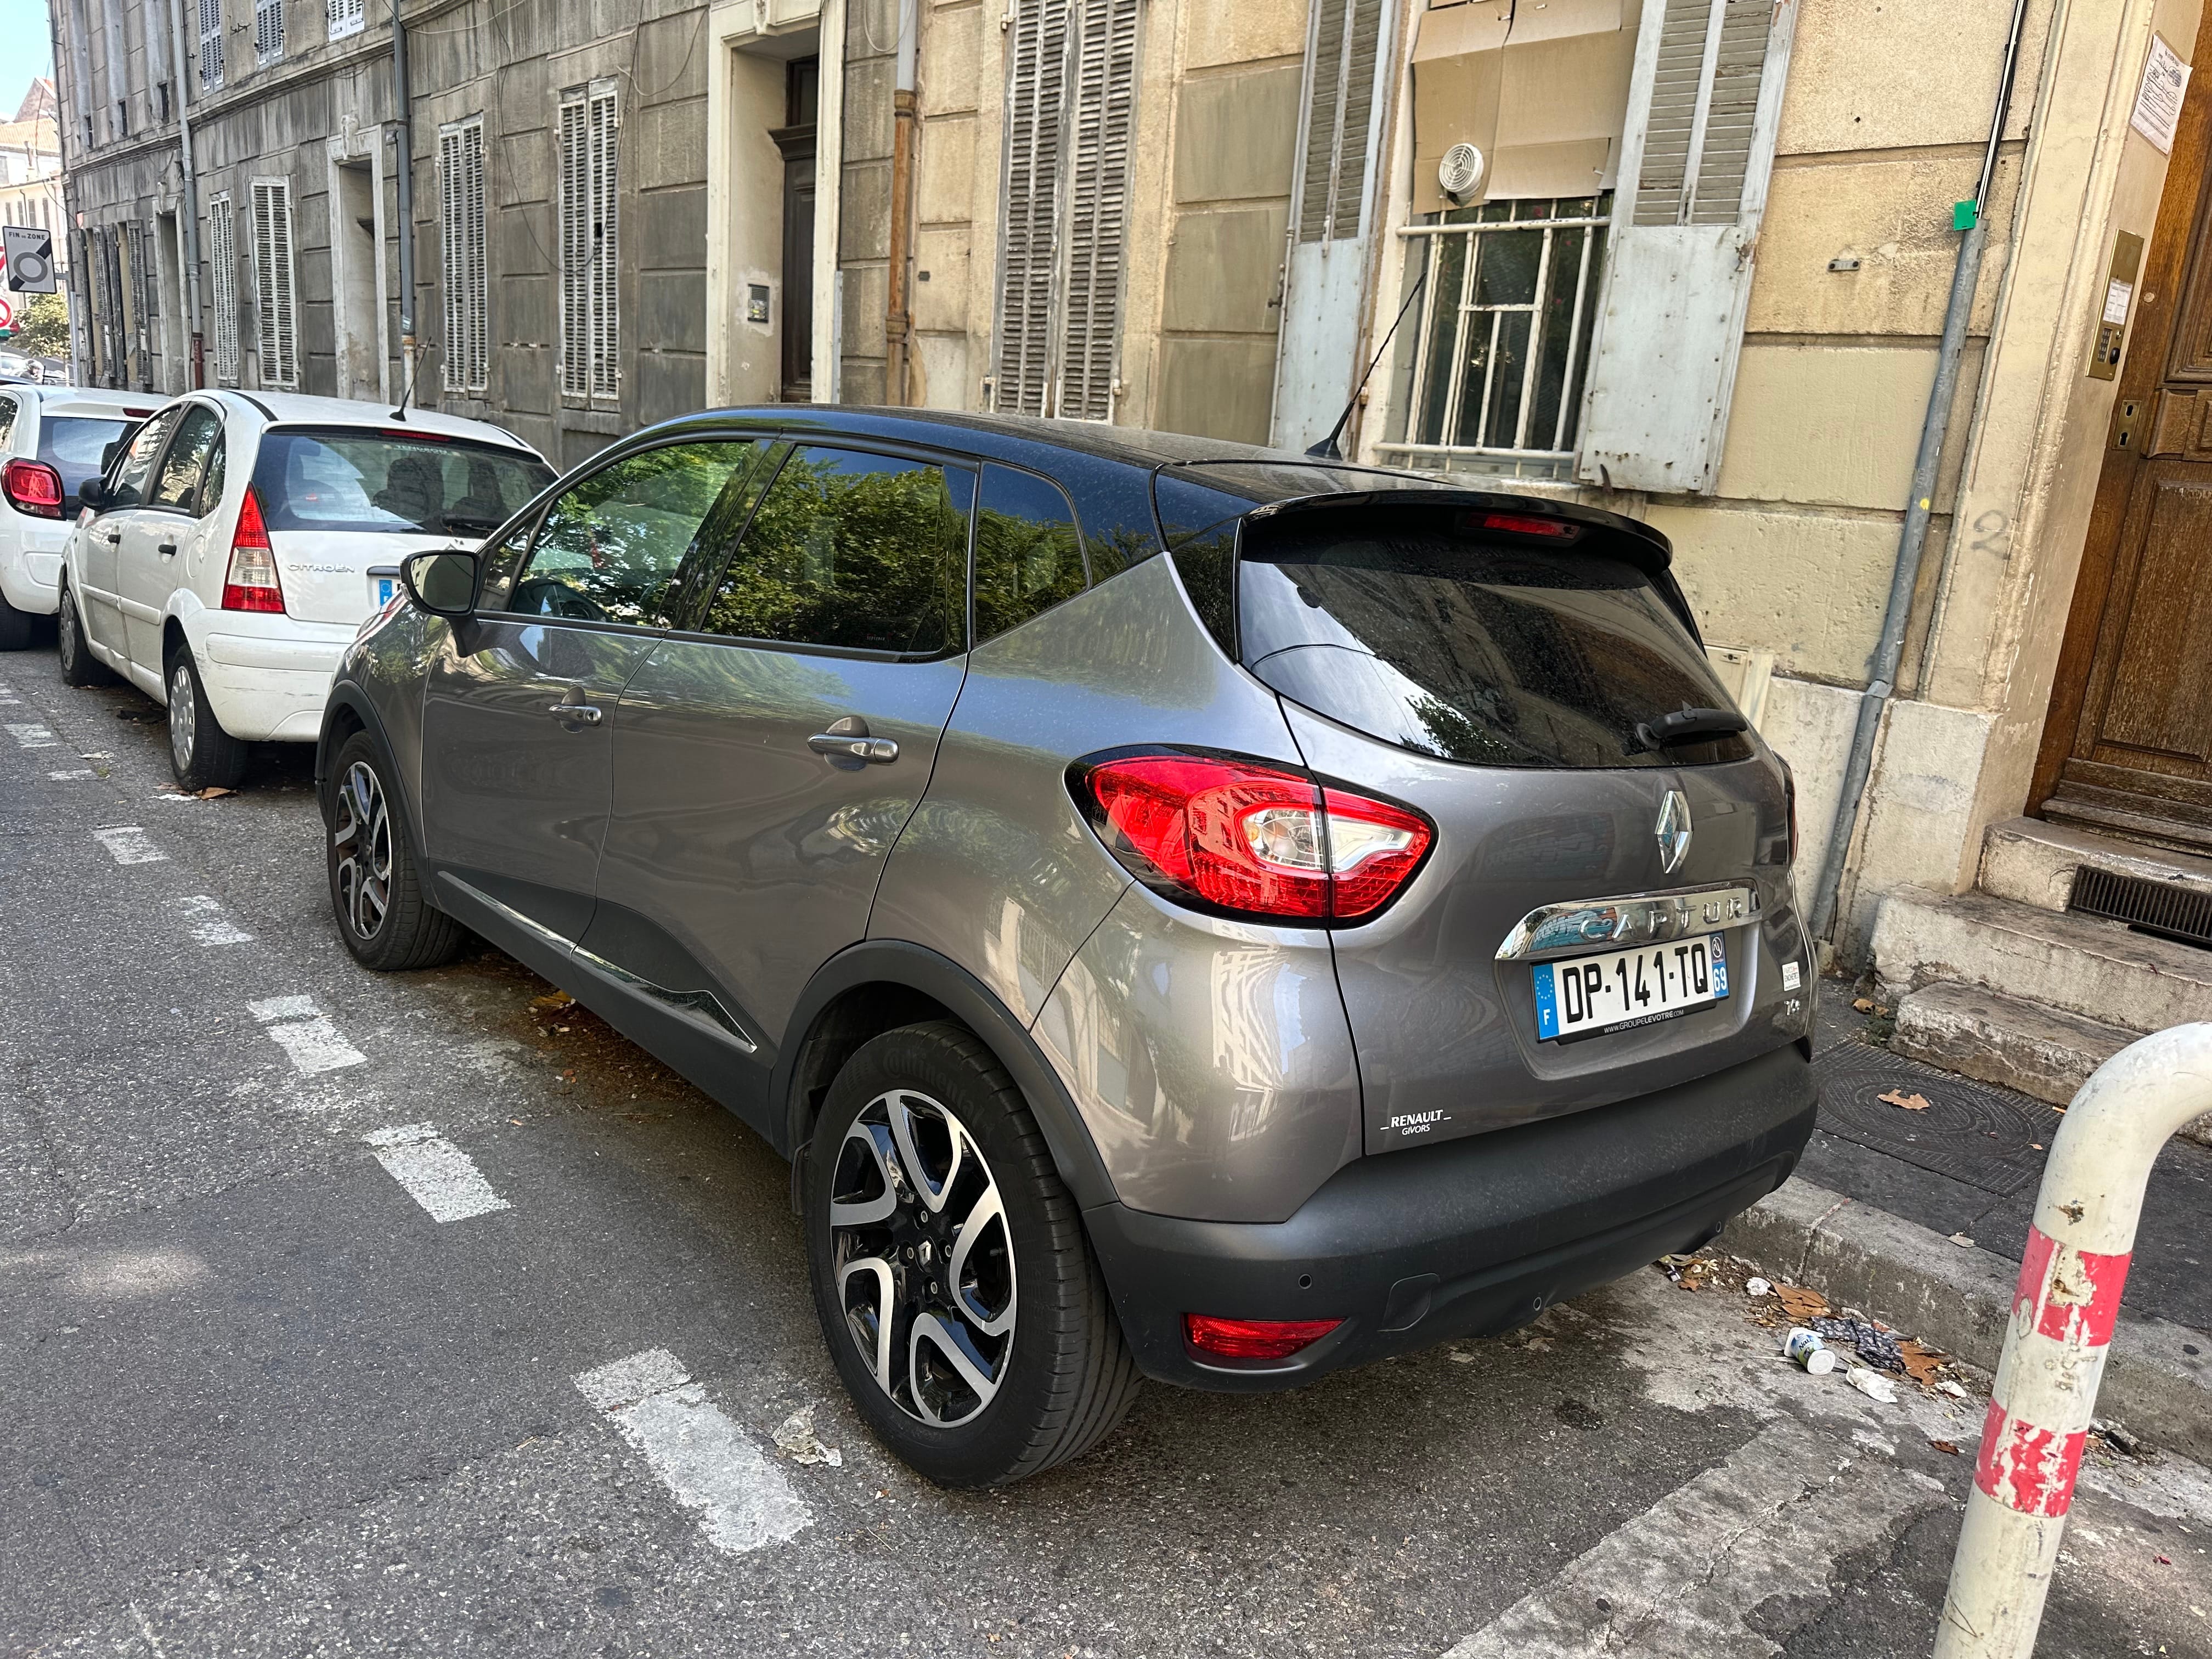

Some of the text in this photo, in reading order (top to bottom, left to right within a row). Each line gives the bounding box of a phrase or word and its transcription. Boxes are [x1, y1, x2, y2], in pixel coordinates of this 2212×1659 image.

[287, 563, 355, 573] CITROËN
[1579, 896, 1742, 941] CAPTUR
[1562, 943, 1708, 1024] DP-141-TQ
[1713, 967, 1728, 992] 69
[1543, 1008, 1550, 1025] F
[1391, 1109, 1443, 1128] RENAULT
[1402, 1124, 1430, 1135] GIVORS
